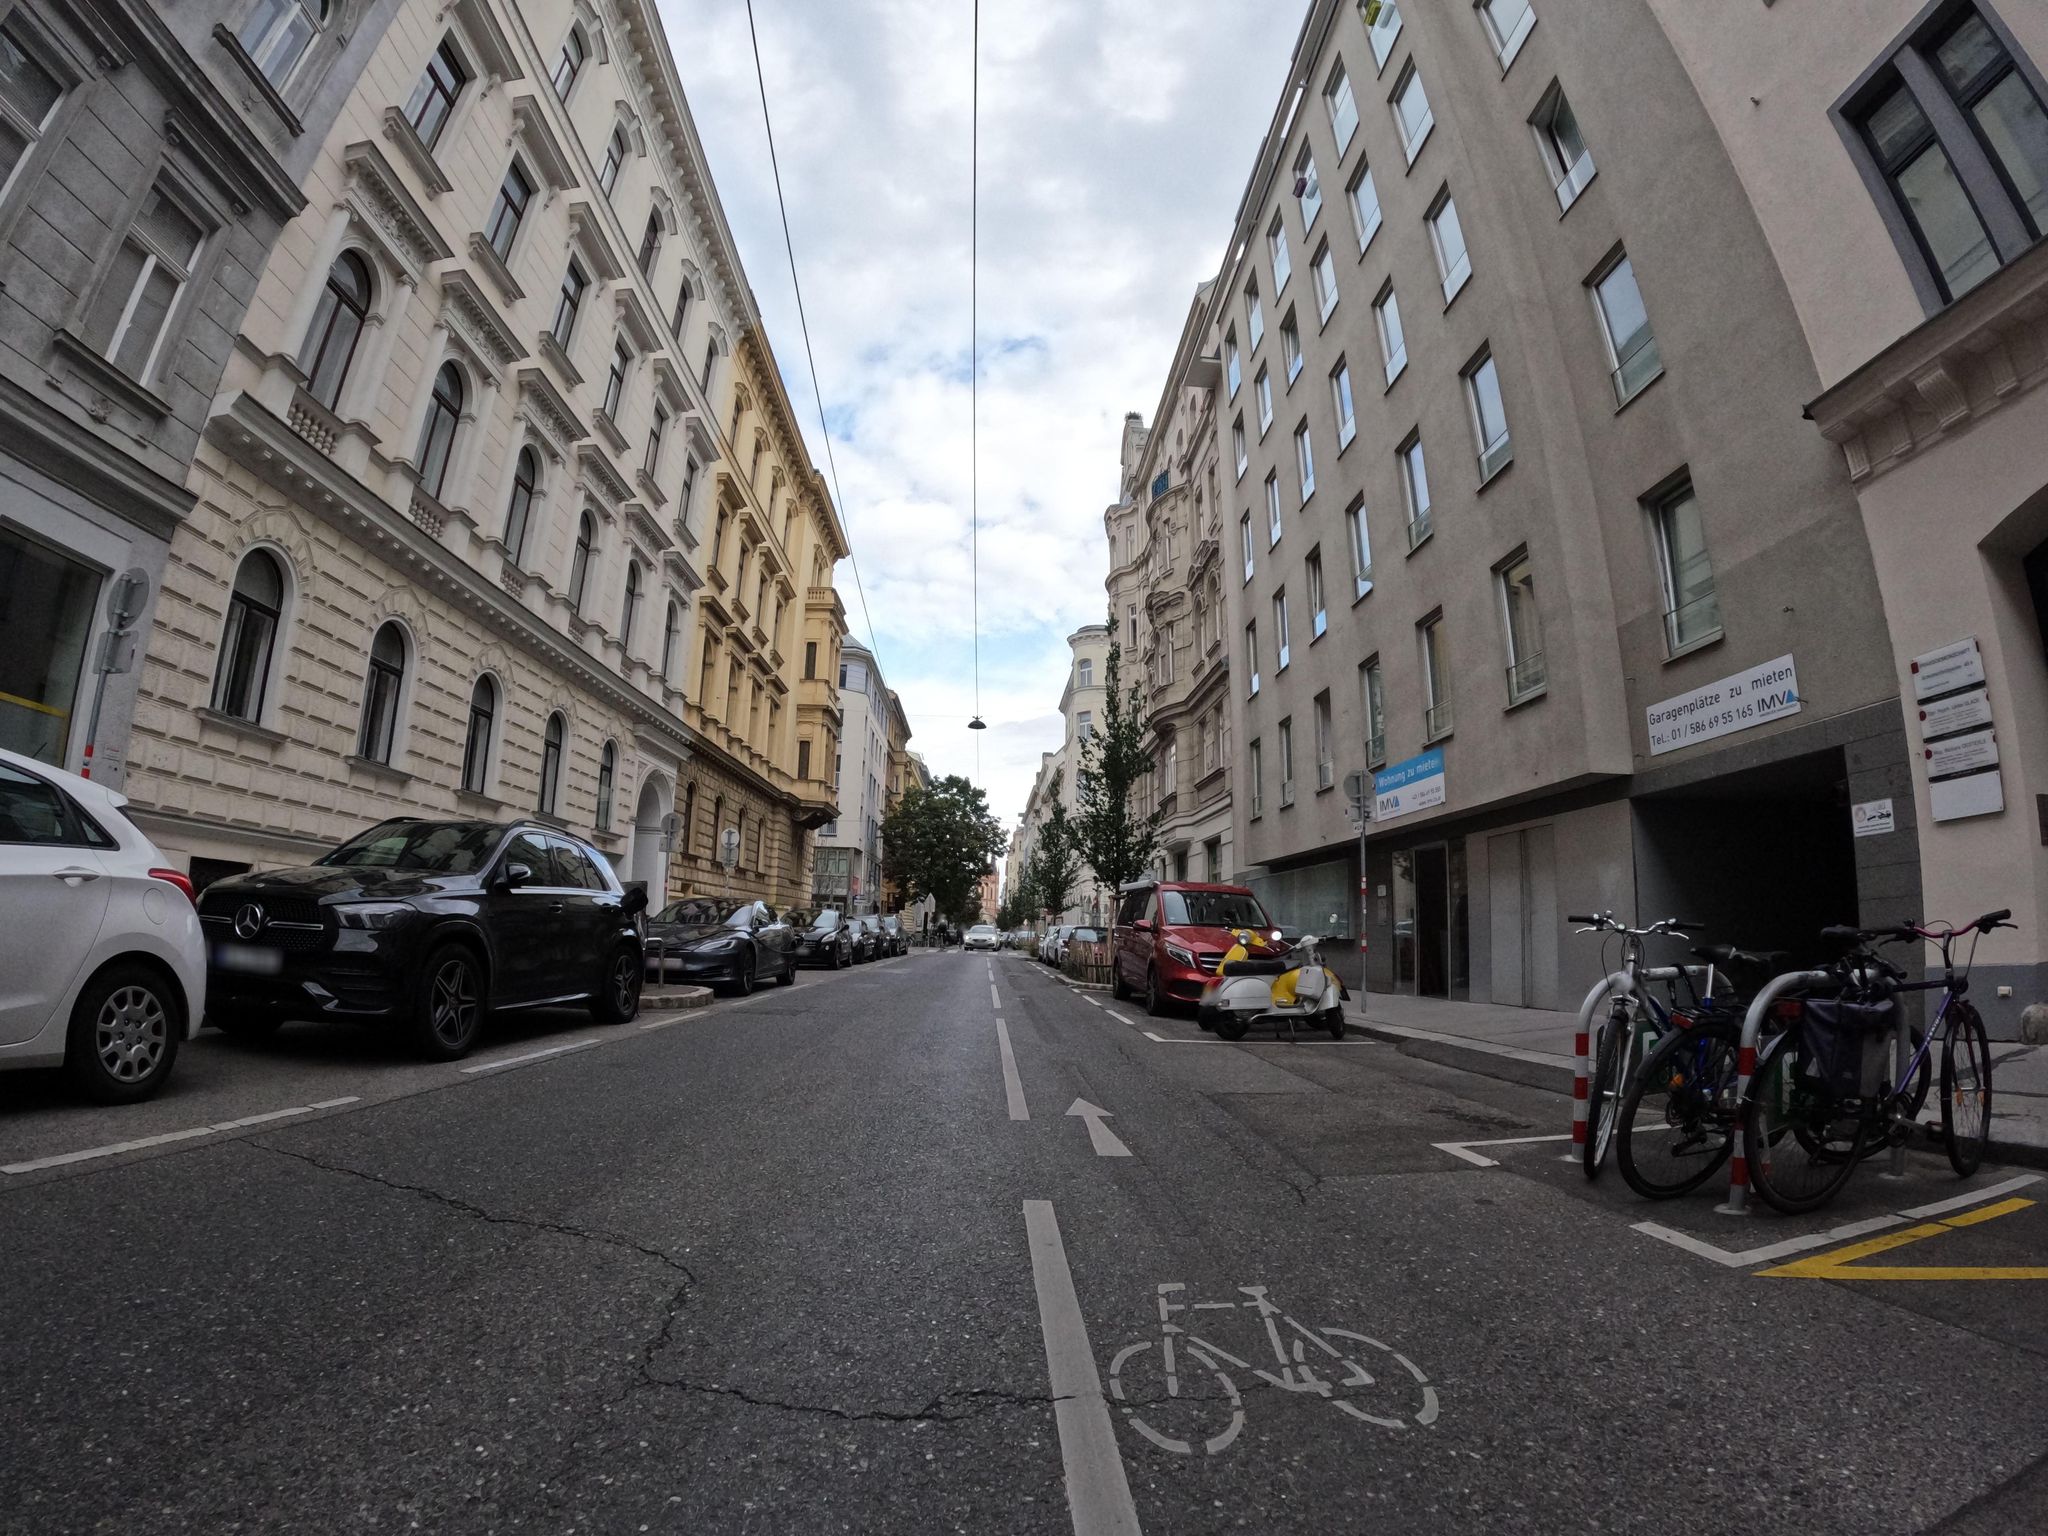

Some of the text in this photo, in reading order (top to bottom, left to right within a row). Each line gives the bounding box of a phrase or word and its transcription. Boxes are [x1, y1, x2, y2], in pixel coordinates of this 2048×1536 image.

[1649, 667, 1793, 726] Garagenplätze zu mieten
[1651, 734, 1670, 747] Tel.:
[1671, 728, 1681, 741] 01
[1684, 726, 1688, 738] /
[1690, 721, 1706, 735] 586
[1708, 715, 1719, 729] 69
[1721, 711, 1733, 725] 55
[1736, 704, 1754, 721] 165
[1378, 771, 1406, 788] Wohnung
[1407, 768, 1415, 778] zu
